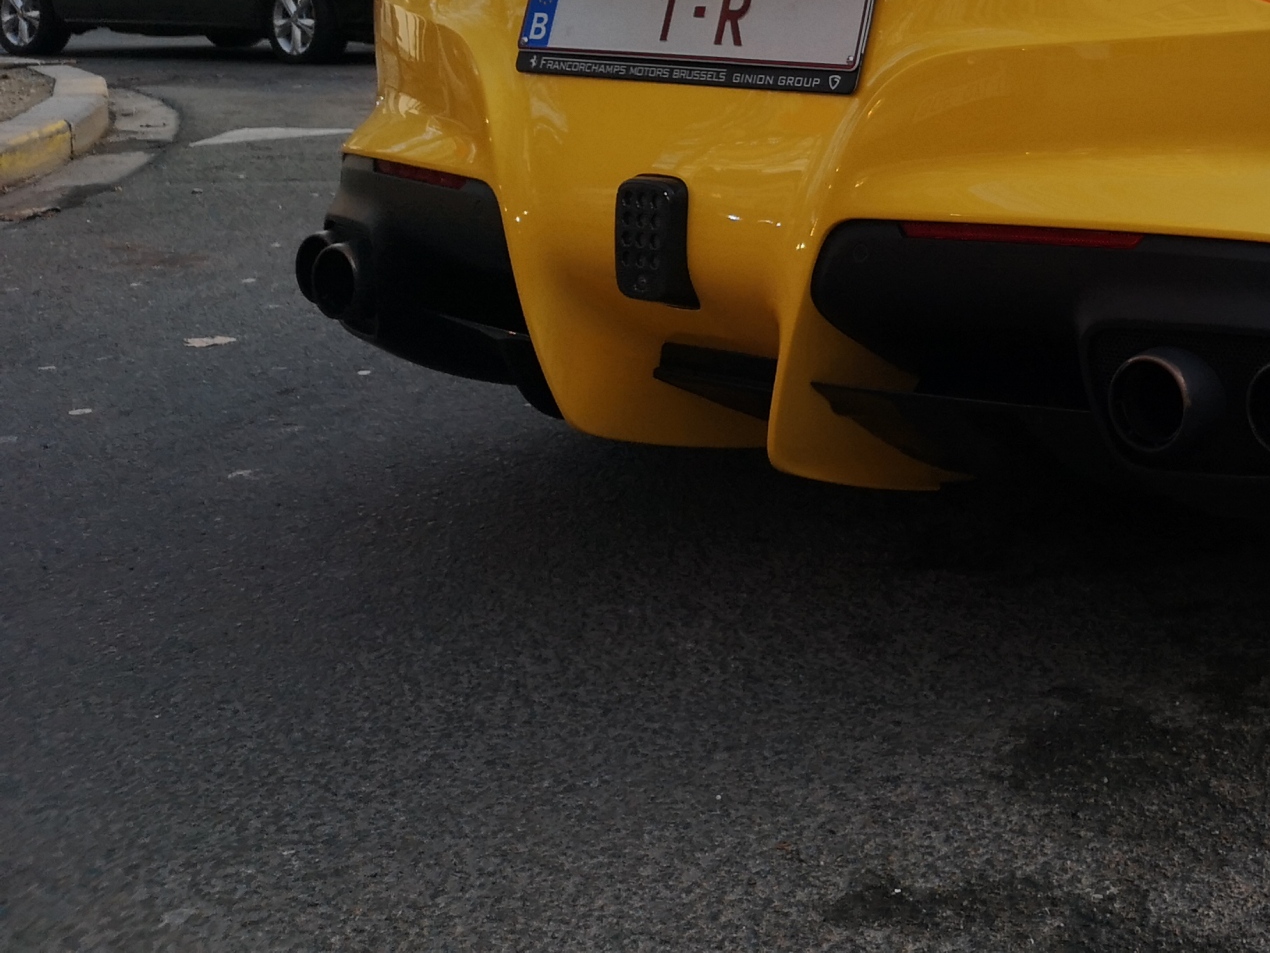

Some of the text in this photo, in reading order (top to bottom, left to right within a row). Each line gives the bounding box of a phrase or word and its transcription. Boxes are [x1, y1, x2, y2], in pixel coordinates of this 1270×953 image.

[529, 12, 549, 40] B
[539, 56, 821, 88] FRANCORCHAMPS MOTORS BRUSSELS GINION GROUP
